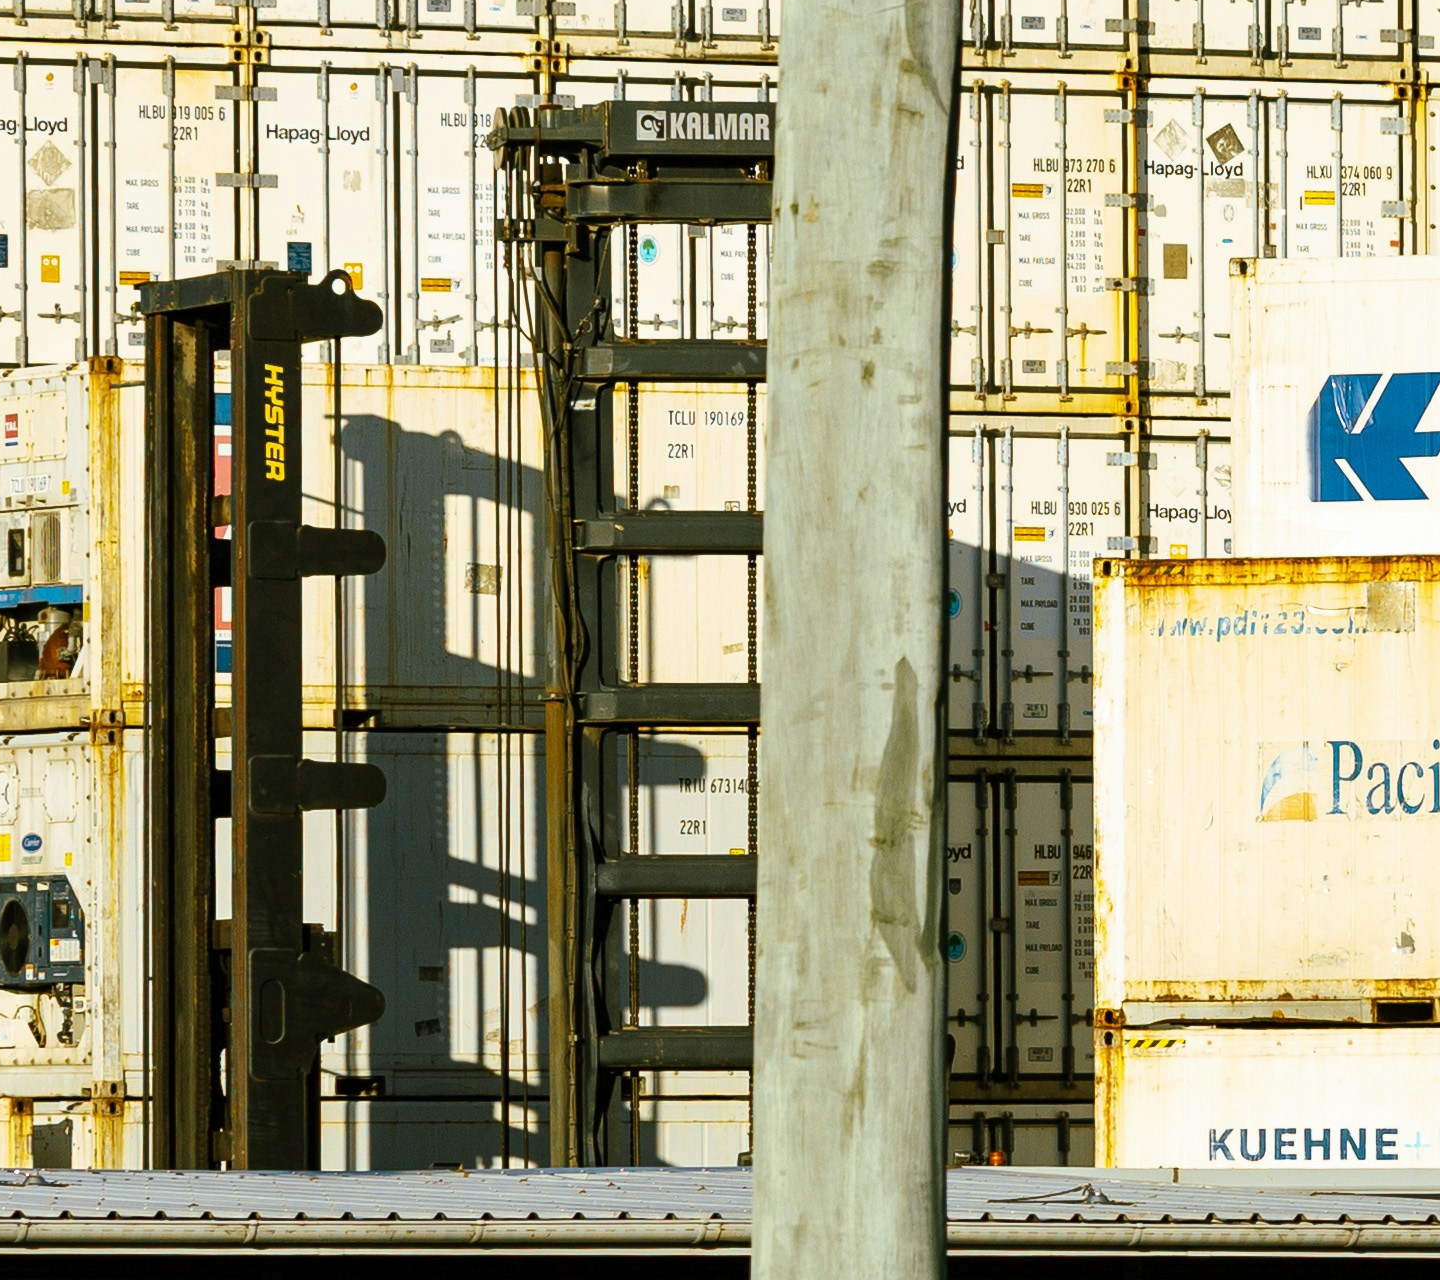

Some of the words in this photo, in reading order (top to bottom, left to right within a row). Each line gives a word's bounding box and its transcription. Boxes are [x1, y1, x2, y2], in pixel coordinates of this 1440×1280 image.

[669, 112, 770, 141] KALMAR
[1144, 160, 1244, 179] Hapag-Lloyd
[265, 363, 285, 483] HYSTER
[668, 410, 696, 426] TCLU
[704, 411, 745, 427] 190169
[667, 444, 695, 459] 22R1
[1209, 1128, 1399, 1162] KUEHNE
